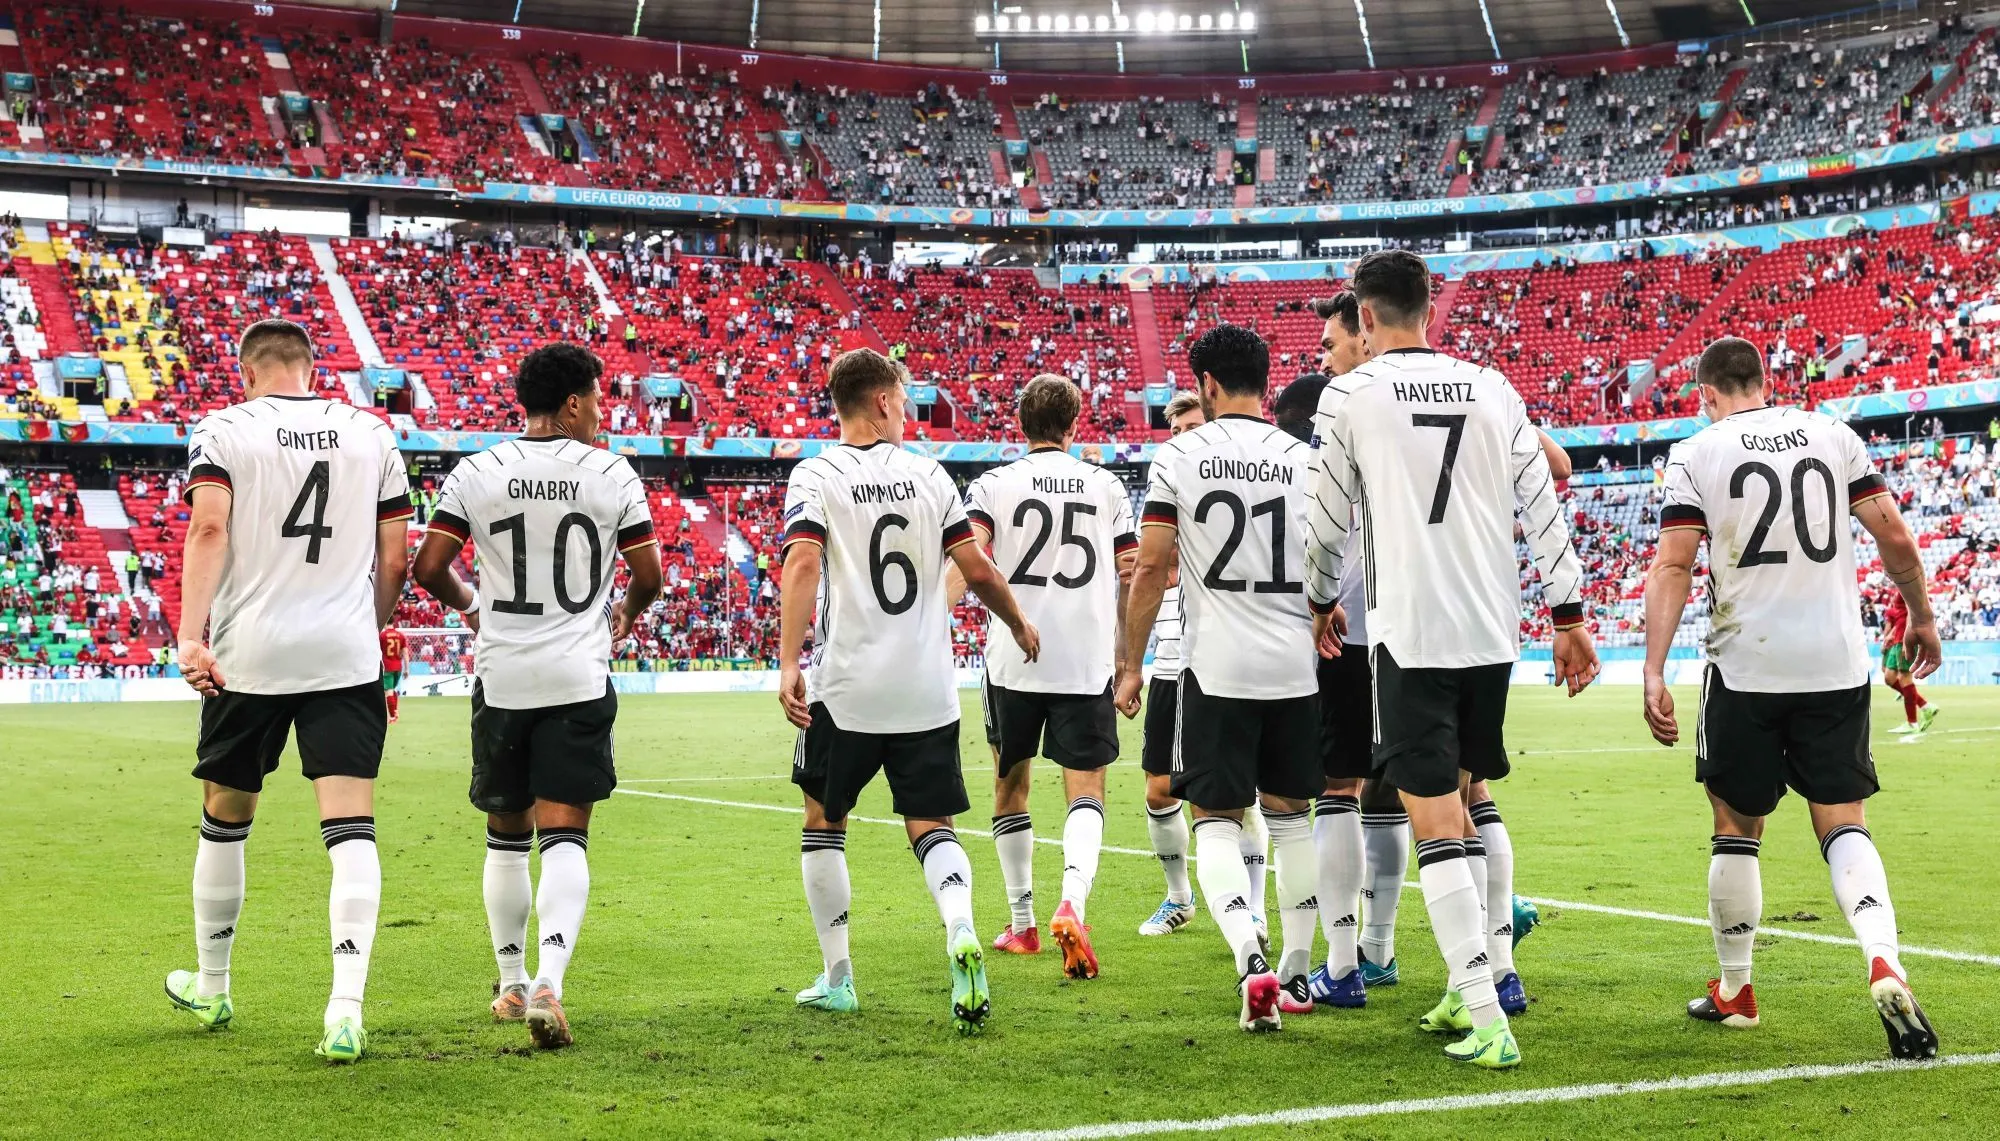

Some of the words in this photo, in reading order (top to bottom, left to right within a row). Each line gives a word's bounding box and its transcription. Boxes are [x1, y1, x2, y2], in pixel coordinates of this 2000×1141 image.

[254, 6, 274, 17] 339
[502, 28, 521, 40] 338
[741, 54, 759, 65] 337
[1490, 64, 1509, 76] 334
[990, 75, 1007, 86] 336
[1238, 78, 1256, 89] 335
[1778, 162, 1808, 179] MUN
[572, 190, 610, 205] UEFA
[611, 193, 647, 207] EURO
[648, 195, 682, 208] 2020
[1357, 204, 1394, 217] UEFA
[1394, 202, 1430, 215] EURO
[1393, 382, 1476, 403] HAVERTZ
[277, 427, 339, 451] GINTER
[1740, 428, 1809, 453] GOSENS
[1199, 456, 1293, 486] GÜNDOĞAN
[1411, 413, 1467, 525] 7
[508, 478, 580, 501] GNABRY
[851, 480, 917, 505] KIMMICH
[1032, 476, 1085, 494] MÜLLER
[281, 460, 333, 565] 4
[1729, 457, 1837, 569] 20
[1007, 498, 1098, 589] 25
[1193, 489, 1304, 594] 21
[489, 511, 602, 615] 10
[869, 513, 918, 616] 6
[387, 637, 401, 657] 21
[1243, 855, 1265, 866] DFB
